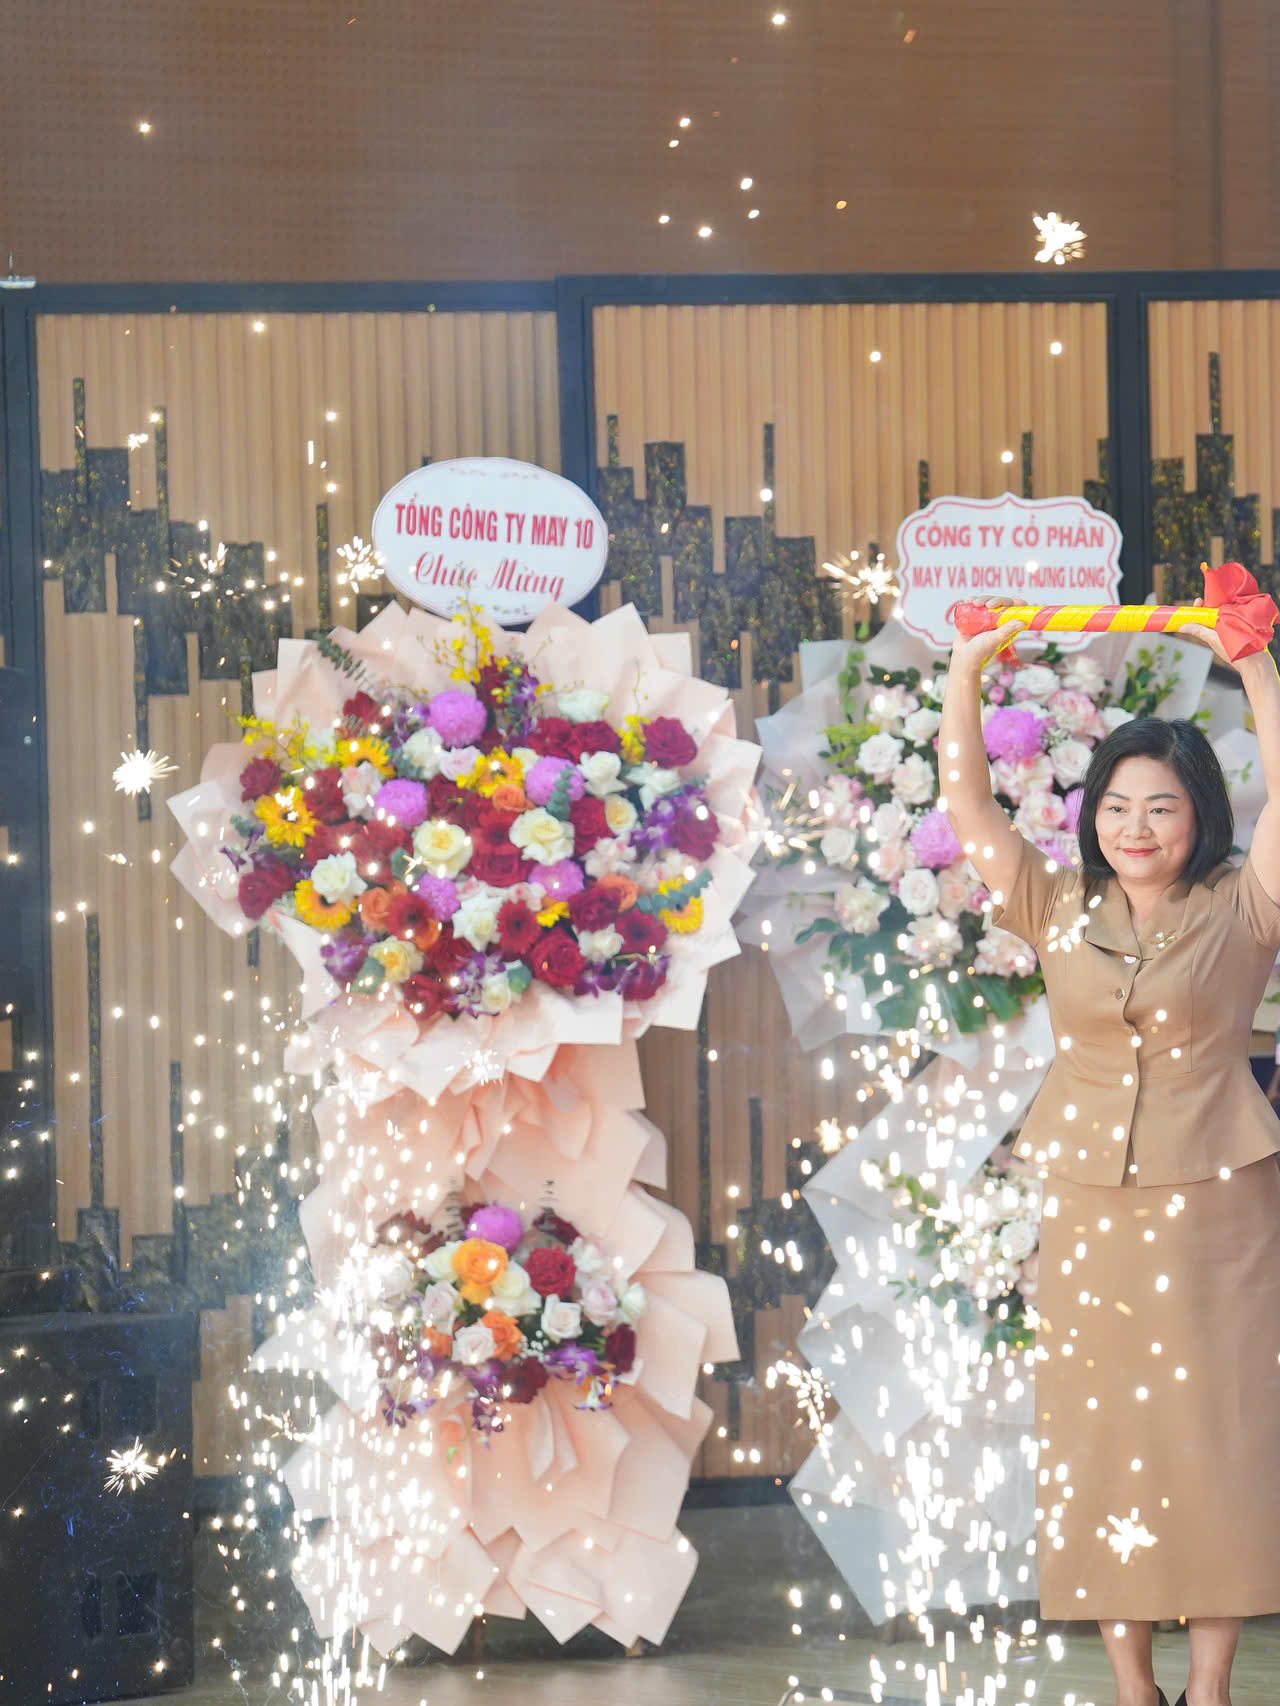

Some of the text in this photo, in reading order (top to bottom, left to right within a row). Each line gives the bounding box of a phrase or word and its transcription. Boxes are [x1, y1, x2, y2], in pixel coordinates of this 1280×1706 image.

[395, 493, 595, 550] TỔNG CÔNG TY MAY 10
[914, 520, 972, 548] CÔNG
[978, 524, 1005, 547] TY
[912, 566, 943, 588] MAY
[947, 562, 968, 588] VÀ
[971, 566, 1001, 593] DỊCH
[1069, 566, 1106, 588] LONG
